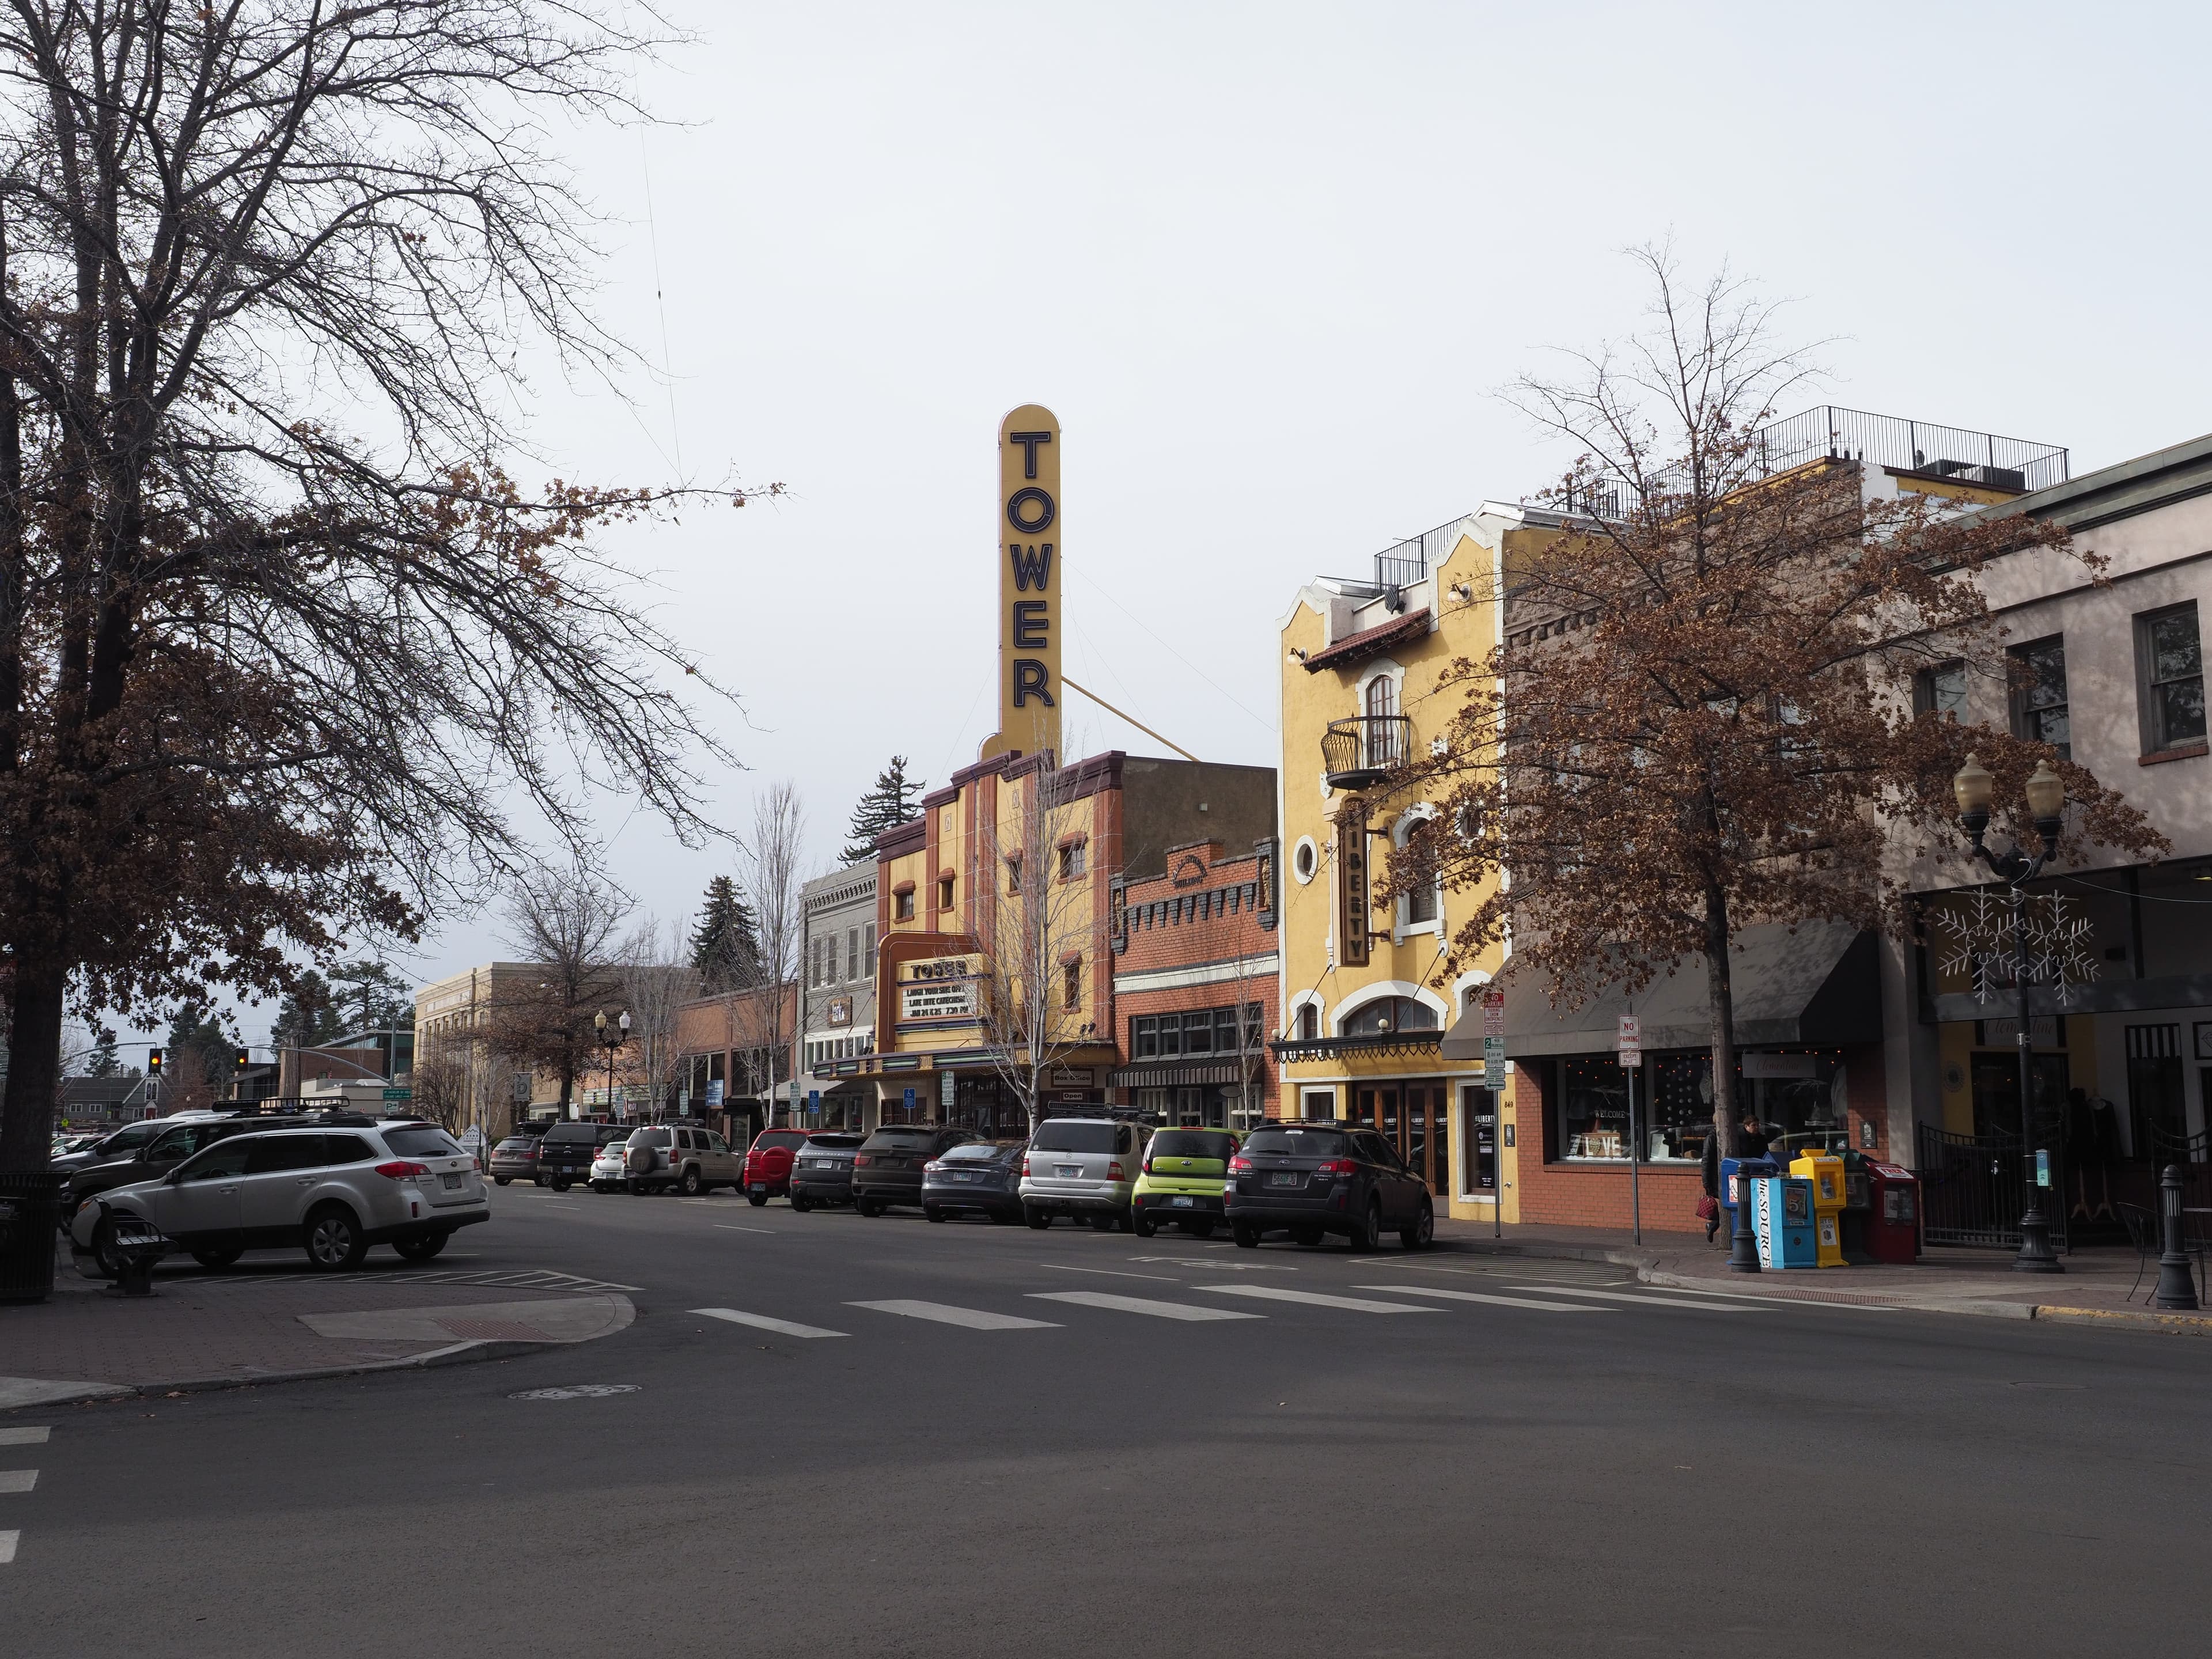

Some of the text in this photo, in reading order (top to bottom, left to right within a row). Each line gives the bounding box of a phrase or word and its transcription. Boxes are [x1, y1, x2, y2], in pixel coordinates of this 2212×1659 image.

[1007, 430, 1054, 707] TOWER
[1173, 876, 1203, 888] BUILDING
[911, 960, 967, 979] TOWER
[1486, 1039, 1490, 1047] 2
[1594, 1110, 1626, 1118] WELCOME
[1585, 1137, 1622, 1156] LVE
[1759, 1199, 1771, 1268] SOURCE
